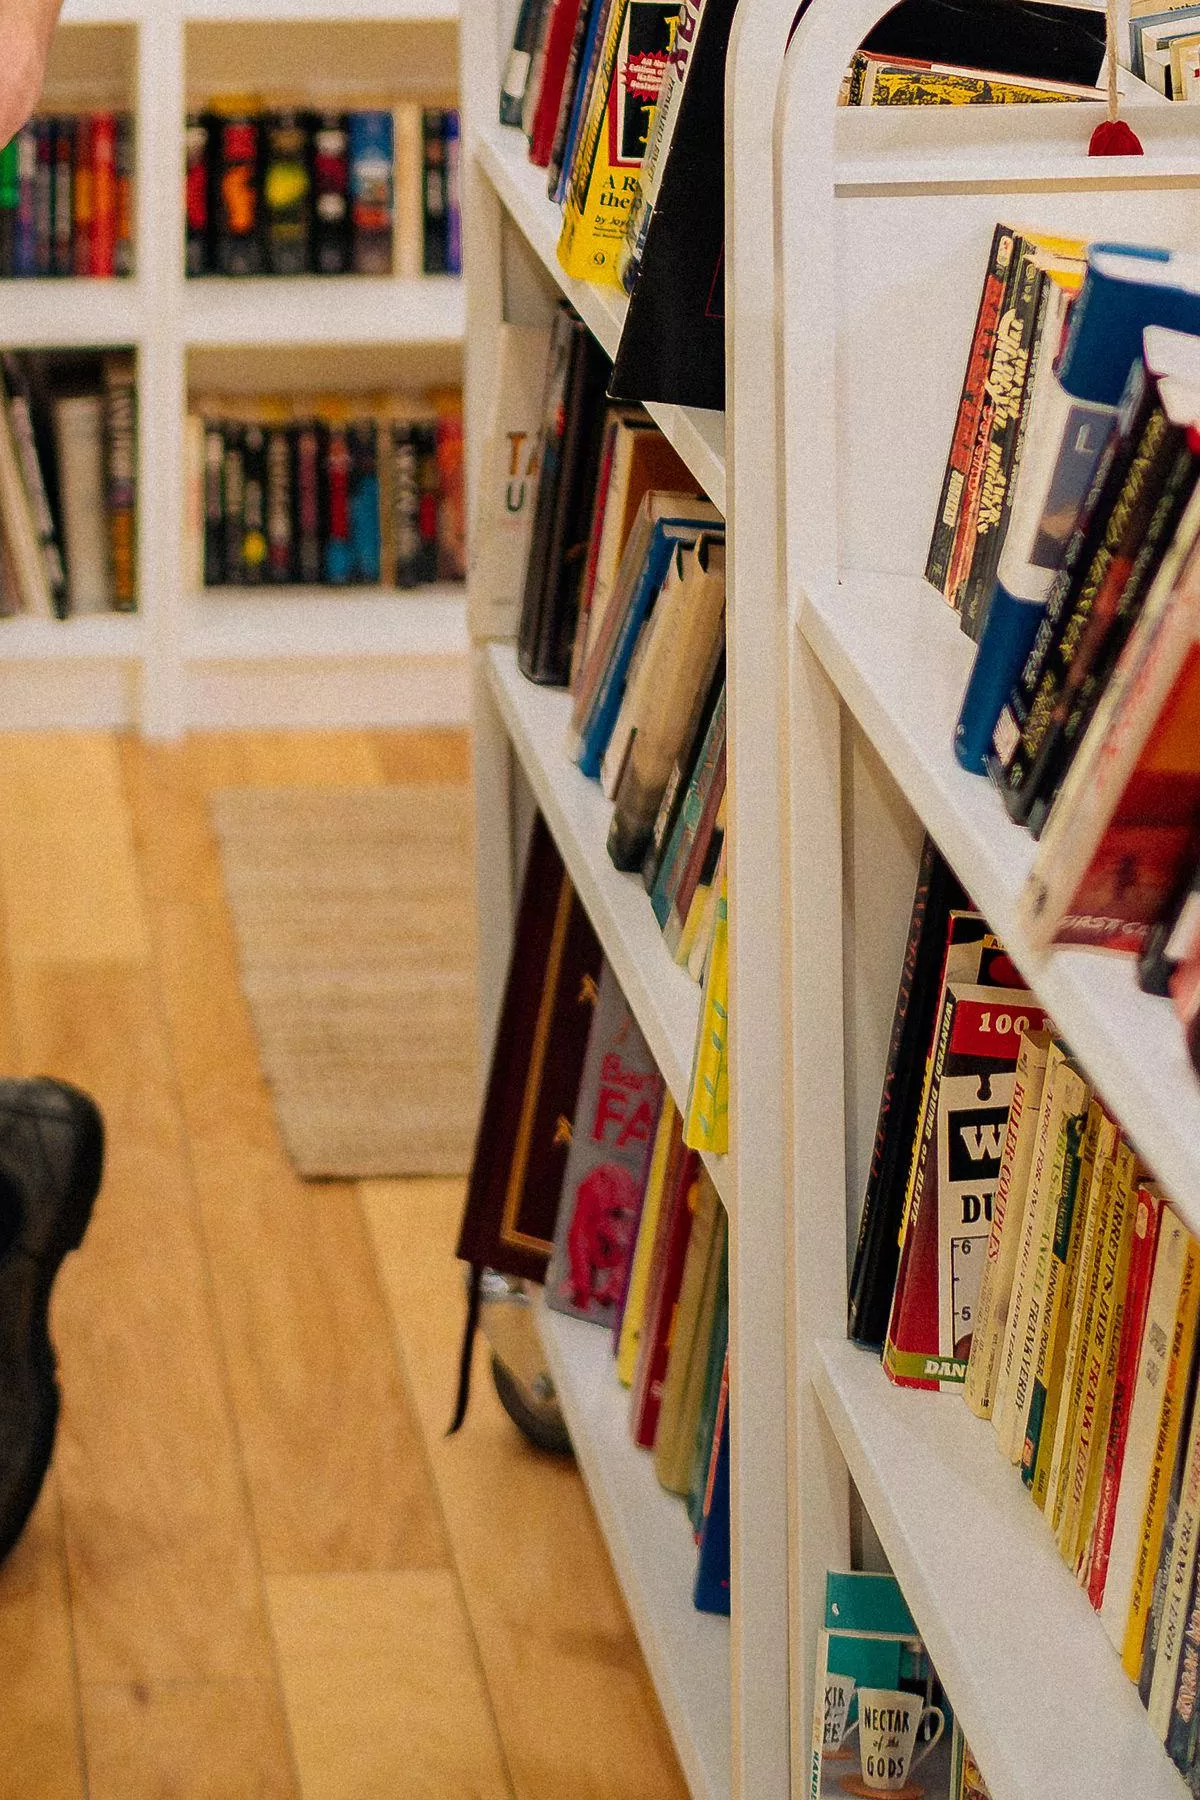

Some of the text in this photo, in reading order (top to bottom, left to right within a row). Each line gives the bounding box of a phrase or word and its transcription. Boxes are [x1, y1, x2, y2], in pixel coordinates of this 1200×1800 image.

[600, 191, 630, 208] the
[603, 174, 616, 189] A
[933, 1002, 954, 1078] WANTED!
[979, 1012, 1030, 1035] 100
[922, 1086, 939, 1139] DUMB
[919, 1143, 928, 1163] or
[987, 1081, 1026, 1263] KILLER COUPLES
[908, 1167, 926, 1224] ALIVE
[961, 1240, 972, 1255] 6
[1003, 1091, 1053, 1376] A ROSE FOR ANA MARIA FRANK YERBY
[961, 1306, 972, 1321] 5
[1041, 1259, 1059, 1326] WINNING
[1091, 1293, 1112, 1350] JADE
[1012, 1296, 1041, 1413] FRANK YERBY
[1034, 1329, 1049, 1377] POKER
[1079, 1356, 1103, 1430] FRANK
[1068, 1435, 1090, 1503] YERBY
[864, 1707, 910, 1734] NECTAR
[873, 1735, 899, 1752] of the
[867, 1756, 904, 1779] GODS
